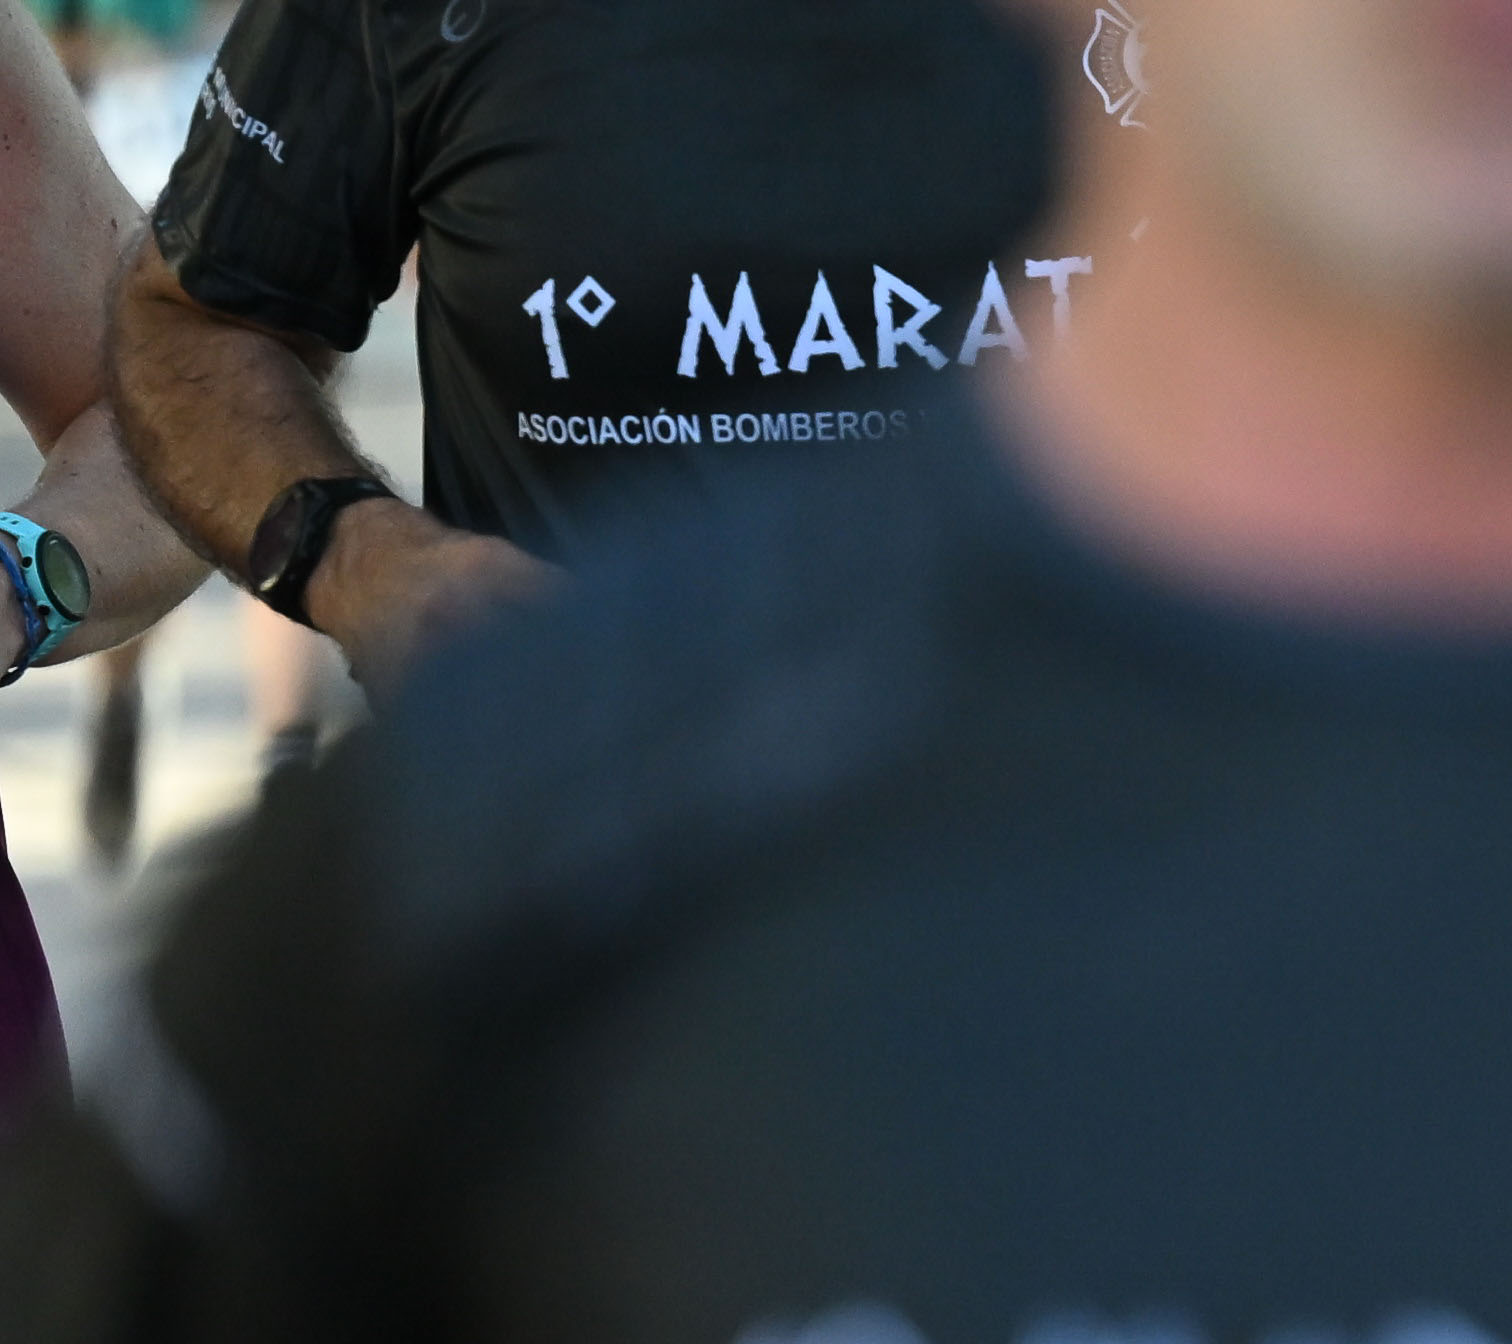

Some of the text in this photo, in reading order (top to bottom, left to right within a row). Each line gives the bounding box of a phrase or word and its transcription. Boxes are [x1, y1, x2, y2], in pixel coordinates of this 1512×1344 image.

[676, 256, 1093, 378] MARAT
[518, 406, 702, 446] ASOCIACIÓN
[710, 408, 908, 444] BOMBEROS
